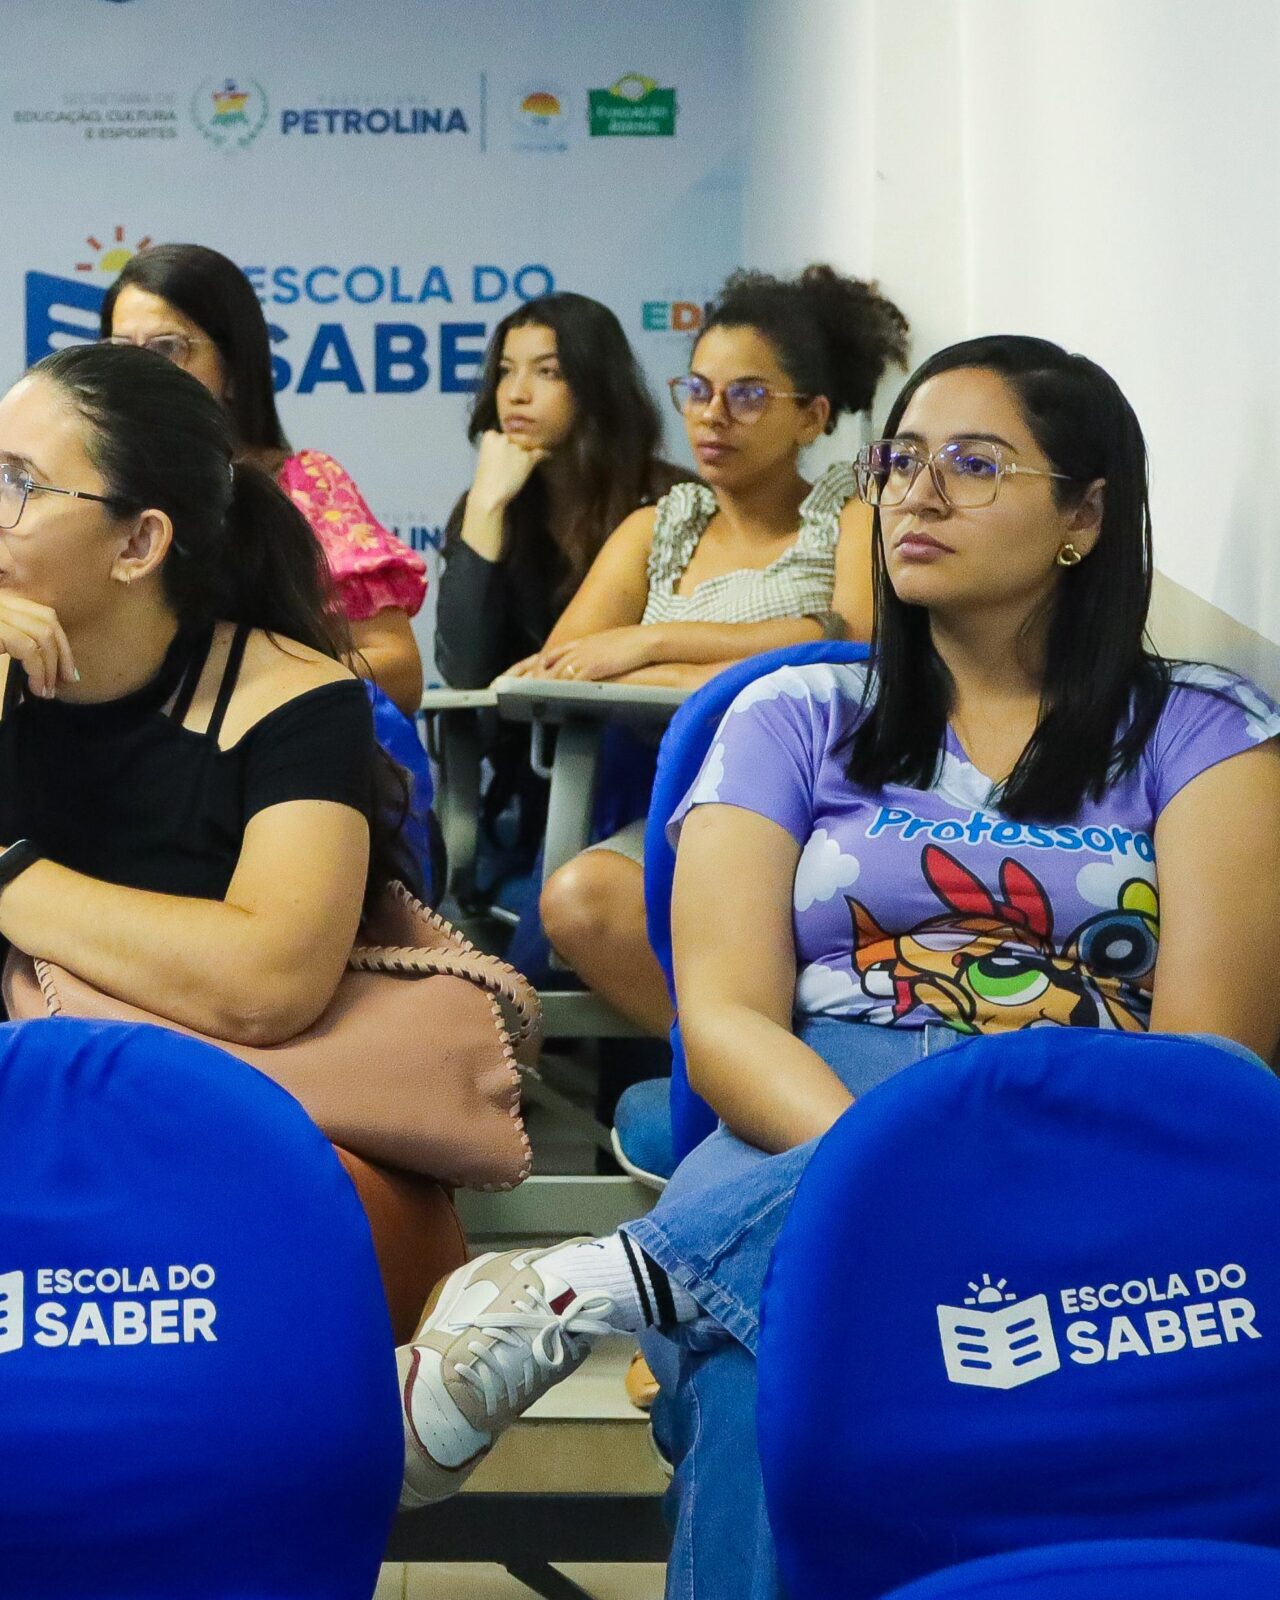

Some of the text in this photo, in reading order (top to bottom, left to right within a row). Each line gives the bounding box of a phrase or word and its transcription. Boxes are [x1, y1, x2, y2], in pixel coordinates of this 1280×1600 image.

[281, 107, 468, 134] PETROLINA
[244, 264, 555, 304] ESCOLA DO
[37, 1263, 216, 1294] ESCOLA DO
[1060, 1263, 1247, 1315] ESCOLA DO
[33, 1297, 218, 1347] SABER
[1065, 1297, 1263, 1365] SABER
